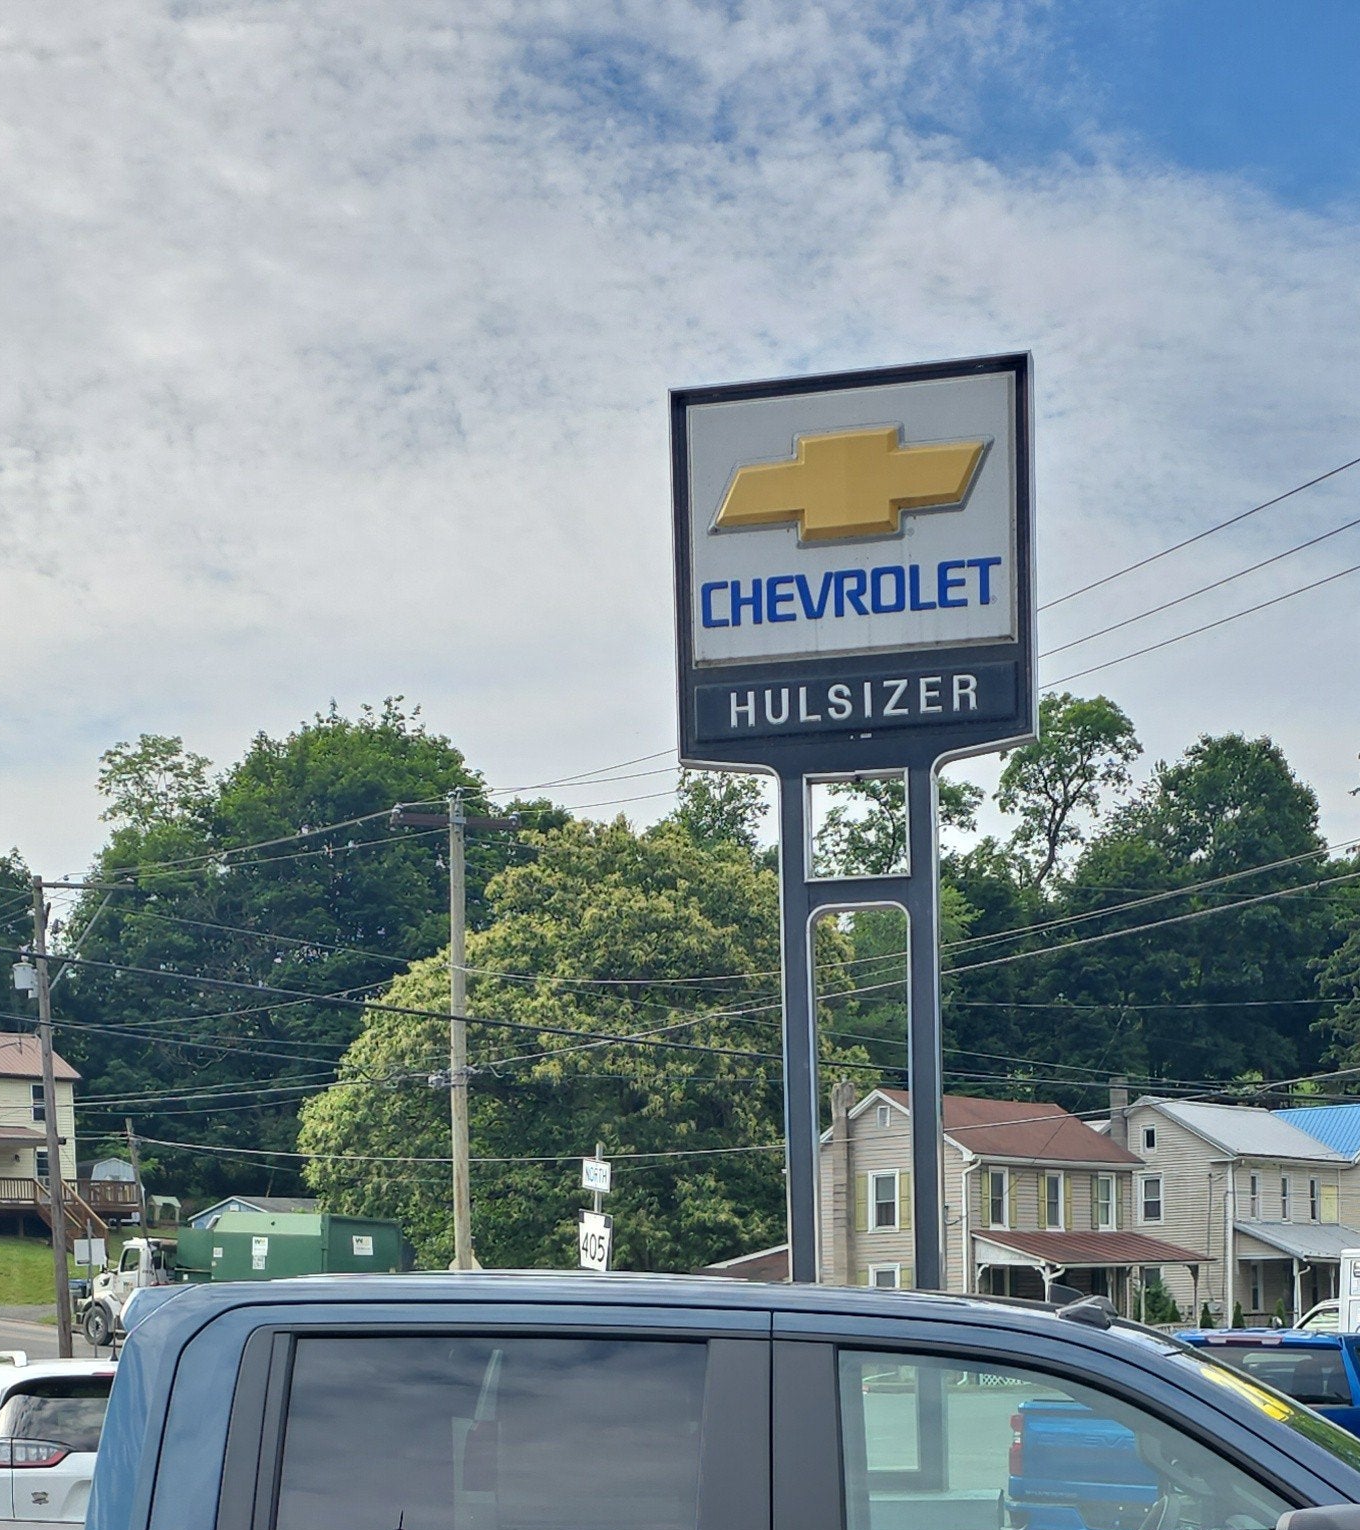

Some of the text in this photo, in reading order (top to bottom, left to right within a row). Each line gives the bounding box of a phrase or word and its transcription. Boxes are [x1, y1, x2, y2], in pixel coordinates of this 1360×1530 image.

[701, 556, 1001, 628] CHEVROLET
[730, 674, 978, 728] HULSIZER
[585, 1166, 607, 1183] NORTH
[582, 1232, 605, 1262] 405
